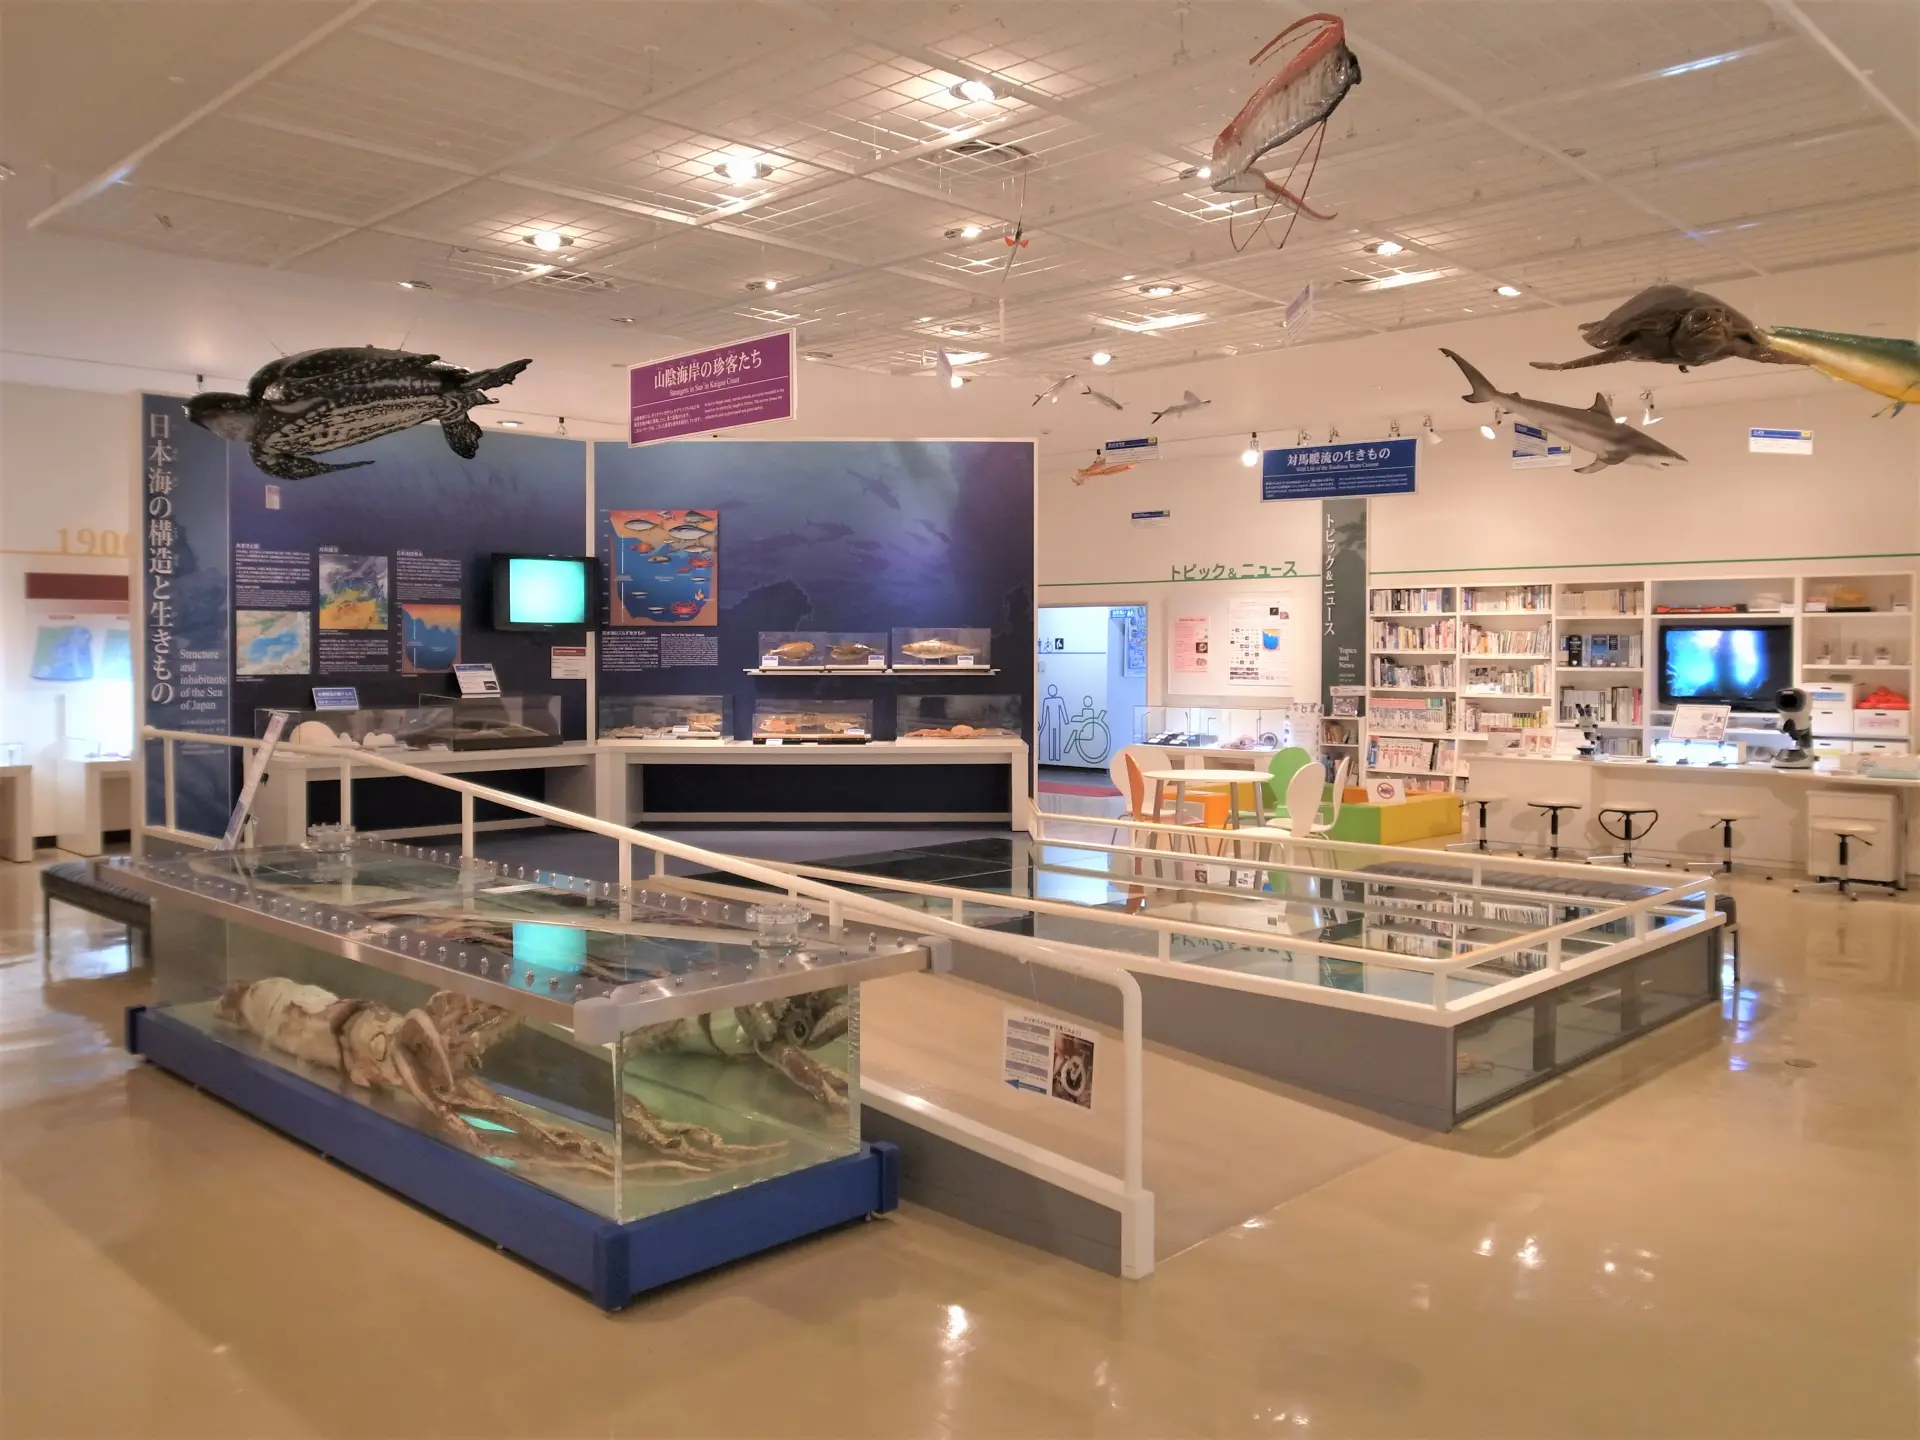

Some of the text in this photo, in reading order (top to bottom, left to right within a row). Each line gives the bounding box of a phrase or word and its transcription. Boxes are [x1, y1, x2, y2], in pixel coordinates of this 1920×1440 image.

[654, 349, 762, 389] 山陰海岸の珍客たち
[1287, 447, 1391, 467] 対馬暖流の生きもの
[148, 413, 174, 705] 日本海の構造と生きもの
[1171, 561, 1298, 581] トピック&ニュース
[1324, 513, 1336, 636] トピック&ニュース
[180, 649, 219, 660] Structure
[180, 662, 196, 672] and
[180, 674, 227, 685] inhabitants
[180, 687, 222, 698] of the Sea
[180, 700, 216, 712] of Japan
